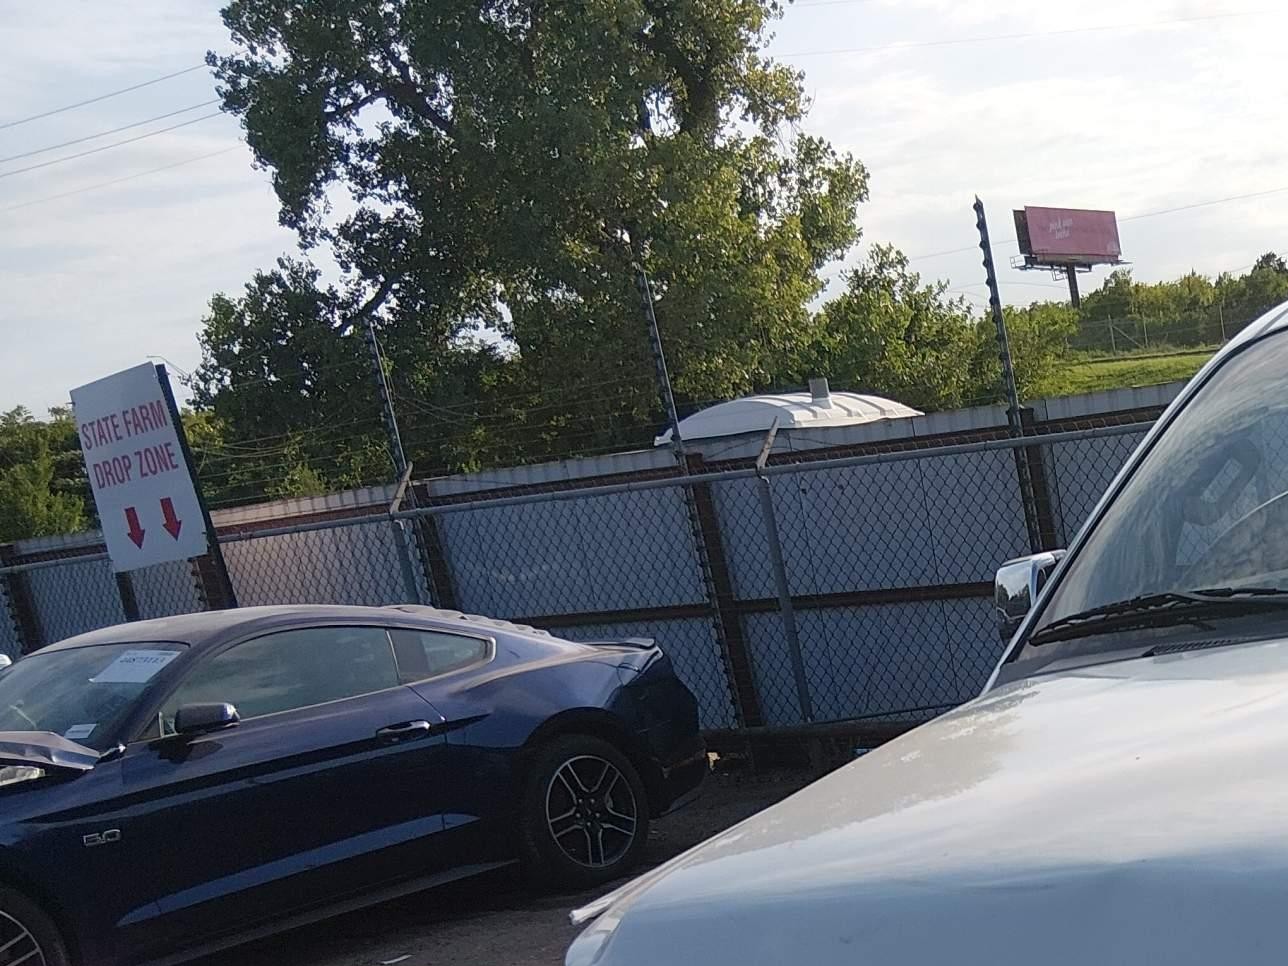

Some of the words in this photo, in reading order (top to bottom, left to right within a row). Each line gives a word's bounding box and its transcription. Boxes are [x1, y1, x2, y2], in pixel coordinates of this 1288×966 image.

[82, 415, 123, 450] STATE
[124, 400, 168, 436] FARM
[94, 455, 132, 489] DROP
[135, 443, 179, 478] ZONE
